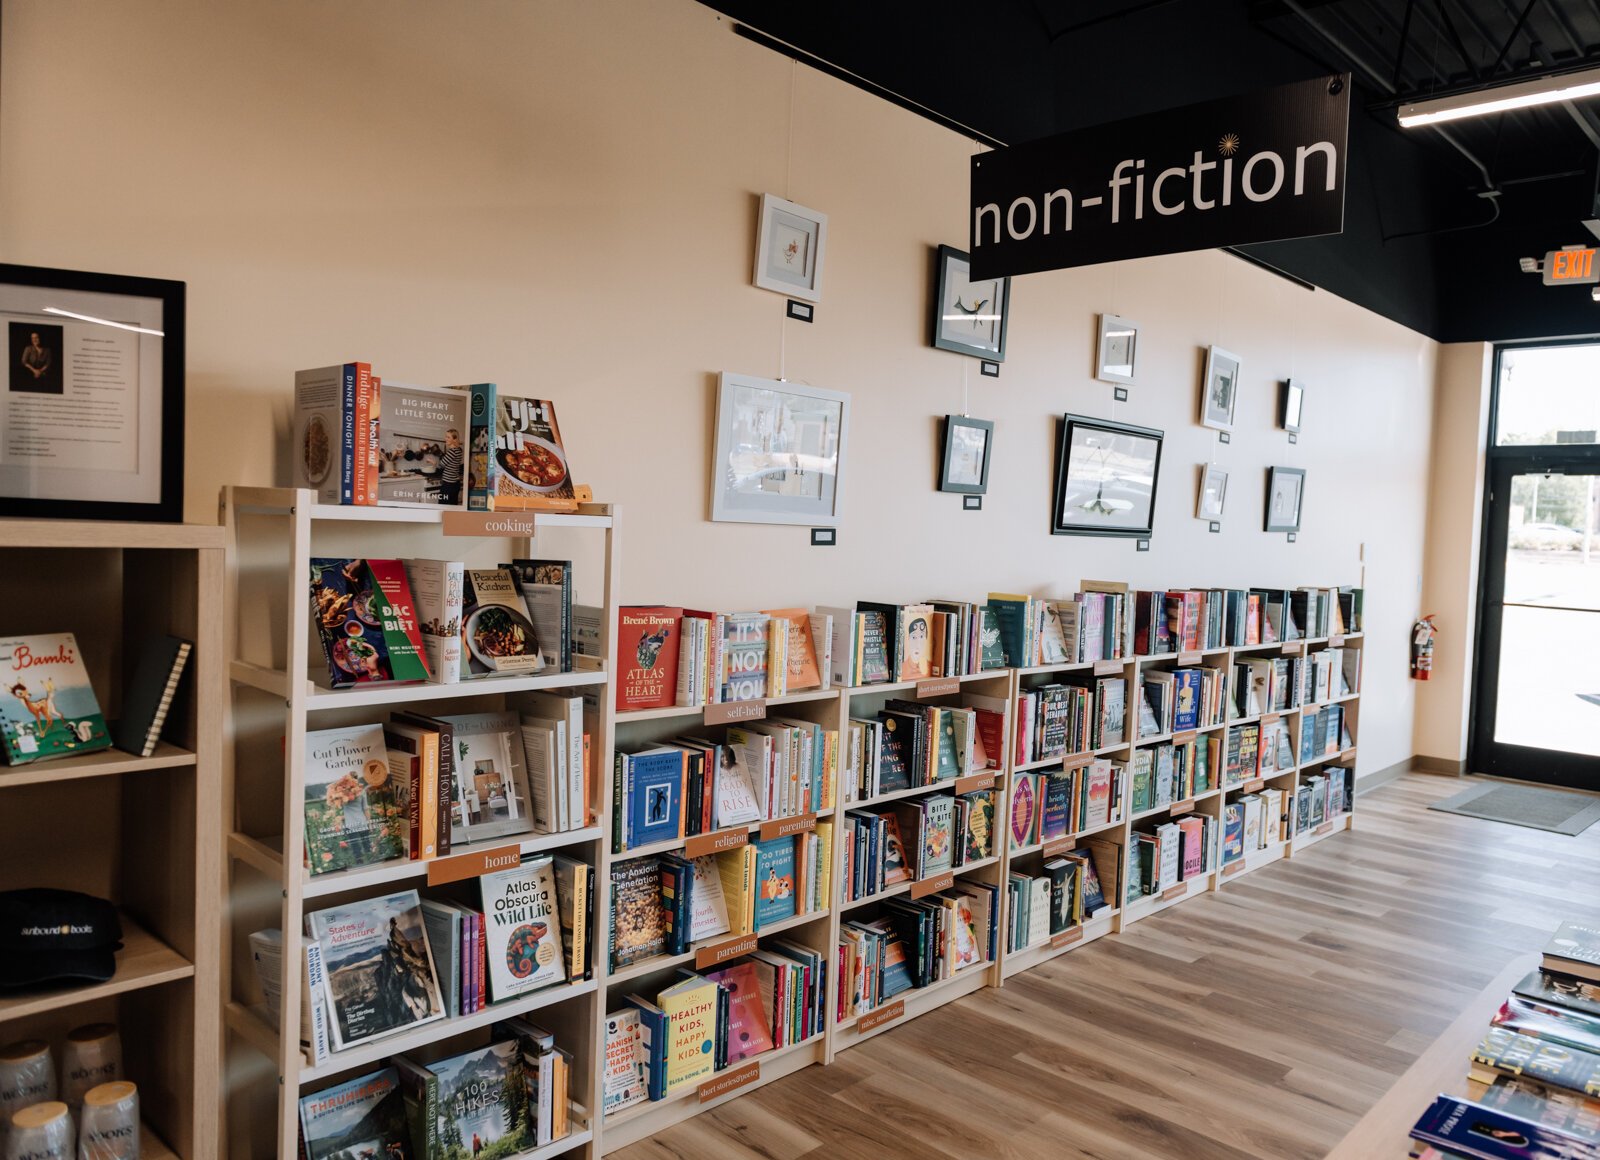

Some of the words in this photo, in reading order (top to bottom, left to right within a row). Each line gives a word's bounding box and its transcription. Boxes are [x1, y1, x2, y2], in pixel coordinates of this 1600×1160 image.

[974, 133, 1336, 247] non-fiction
[1552, 249, 1596, 279] EXIT
[357, 369, 370, 409] indulge
[402, 398, 417, 408] BIG
[421, 400, 449, 411] HEART
[395, 408, 423, 419] LITTLE
[426, 410, 454, 422] STOVE
[345, 411, 353, 448] TONIGHT
[369, 420, 378, 449] health
[368, 451, 377, 464] nut
[358, 446, 366, 490] BERTINELLI
[393, 490, 413, 500] ERIN
[416, 491, 449, 501] FRENCH
[485, 519, 533, 534] cooking
[448, 572, 462, 581] SALT
[473, 572, 508, 582] Peaceful
[449, 581, 460, 590] FAT
[477, 582, 511, 591] Kitchen
[448, 589, 461, 599] ACID
[446, 598, 461, 607] HEAT
[622, 615, 648, 625] Brené
[649, 615, 675, 625] Brown
[736, 622, 763, 642] IT'S
[12, 644, 75, 671] Bambi
[731, 651, 765, 673] NOT
[626, 668, 665, 680] ATLAS
[625, 685, 664, 696] HEART
[730, 680, 765, 702] YOU
[727, 705, 764, 719] self-help
[1180, 714, 1192, 723] Wife
[313, 748, 332, 759] Cut
[335, 745, 371, 757] Flower
[441, 734, 450, 760] CALL
[888, 741, 902, 750] THE
[325, 757, 363, 770] Garden
[440, 762, 450, 771] IT
[891, 763, 905, 773] REZ
[411, 778, 419, 800] Wear
[440, 774, 450, 806] HOME
[729, 789, 740, 798] TO
[722, 796, 752, 811] RISE
[1049, 793, 1065, 802] briefly
[931, 803, 947, 813] BITE
[411, 811, 419, 828] Well
[779, 817, 816, 835] parenting
[926, 816, 934, 824] BY
[937, 812, 951, 822] BITE
[714, 833, 747, 849] religion
[775, 846, 794, 857] TIRED
[484, 852, 519, 869] home
[761, 861, 770, 869] TO
[772, 856, 792, 867] FIGHT
[611, 872, 627, 881] The
[628, 864, 659, 878] Anxious
[505, 879, 537, 896] Atlas
[494, 890, 548, 911] Obscura
[493, 907, 526, 927] Wild
[529, 901, 552, 919] Life
[695, 905, 713, 919] fourth
[328, 924, 357, 936] States
[357, 920, 366, 929] of
[330, 927, 375, 945] Adventure
[617, 943, 647, 956] Jonathan
[647, 937, 664, 947] Haidt
[717, 938, 757, 961] parenting
[307, 948, 316, 987] BOURDAIN
[311, 947, 323, 983] ANTHONY
[315, 1006, 323, 1031] WORLD
[670, 1001, 713, 1022] HEALTHY
[861, 1018, 876, 1029] misc.
[876, 1006, 904, 1024] nonfiction
[347, 1016, 365, 1025] Diaries
[679, 1019, 704, 1034] KIDS,
[317, 1032, 325, 1056] TRAVEL
[606, 1036, 633, 1051] DANISH
[675, 1030, 706, 1048] HAPPY
[606, 1044, 634, 1060] SECRET
[610, 1052, 635, 1068] HAPPY
[678, 1046, 700, 1061] KIDS
[70, 1063, 115, 1080] BOOKS
[613, 1063, 631, 1075] KIDS
[669, 1075, 684, 1086] ELISA
[685, 1071, 700, 1082] SONG,
[464, 1081, 487, 1097] 100
[700, 1084, 716, 1097] short
[455, 1090, 500, 1115] HIKES
